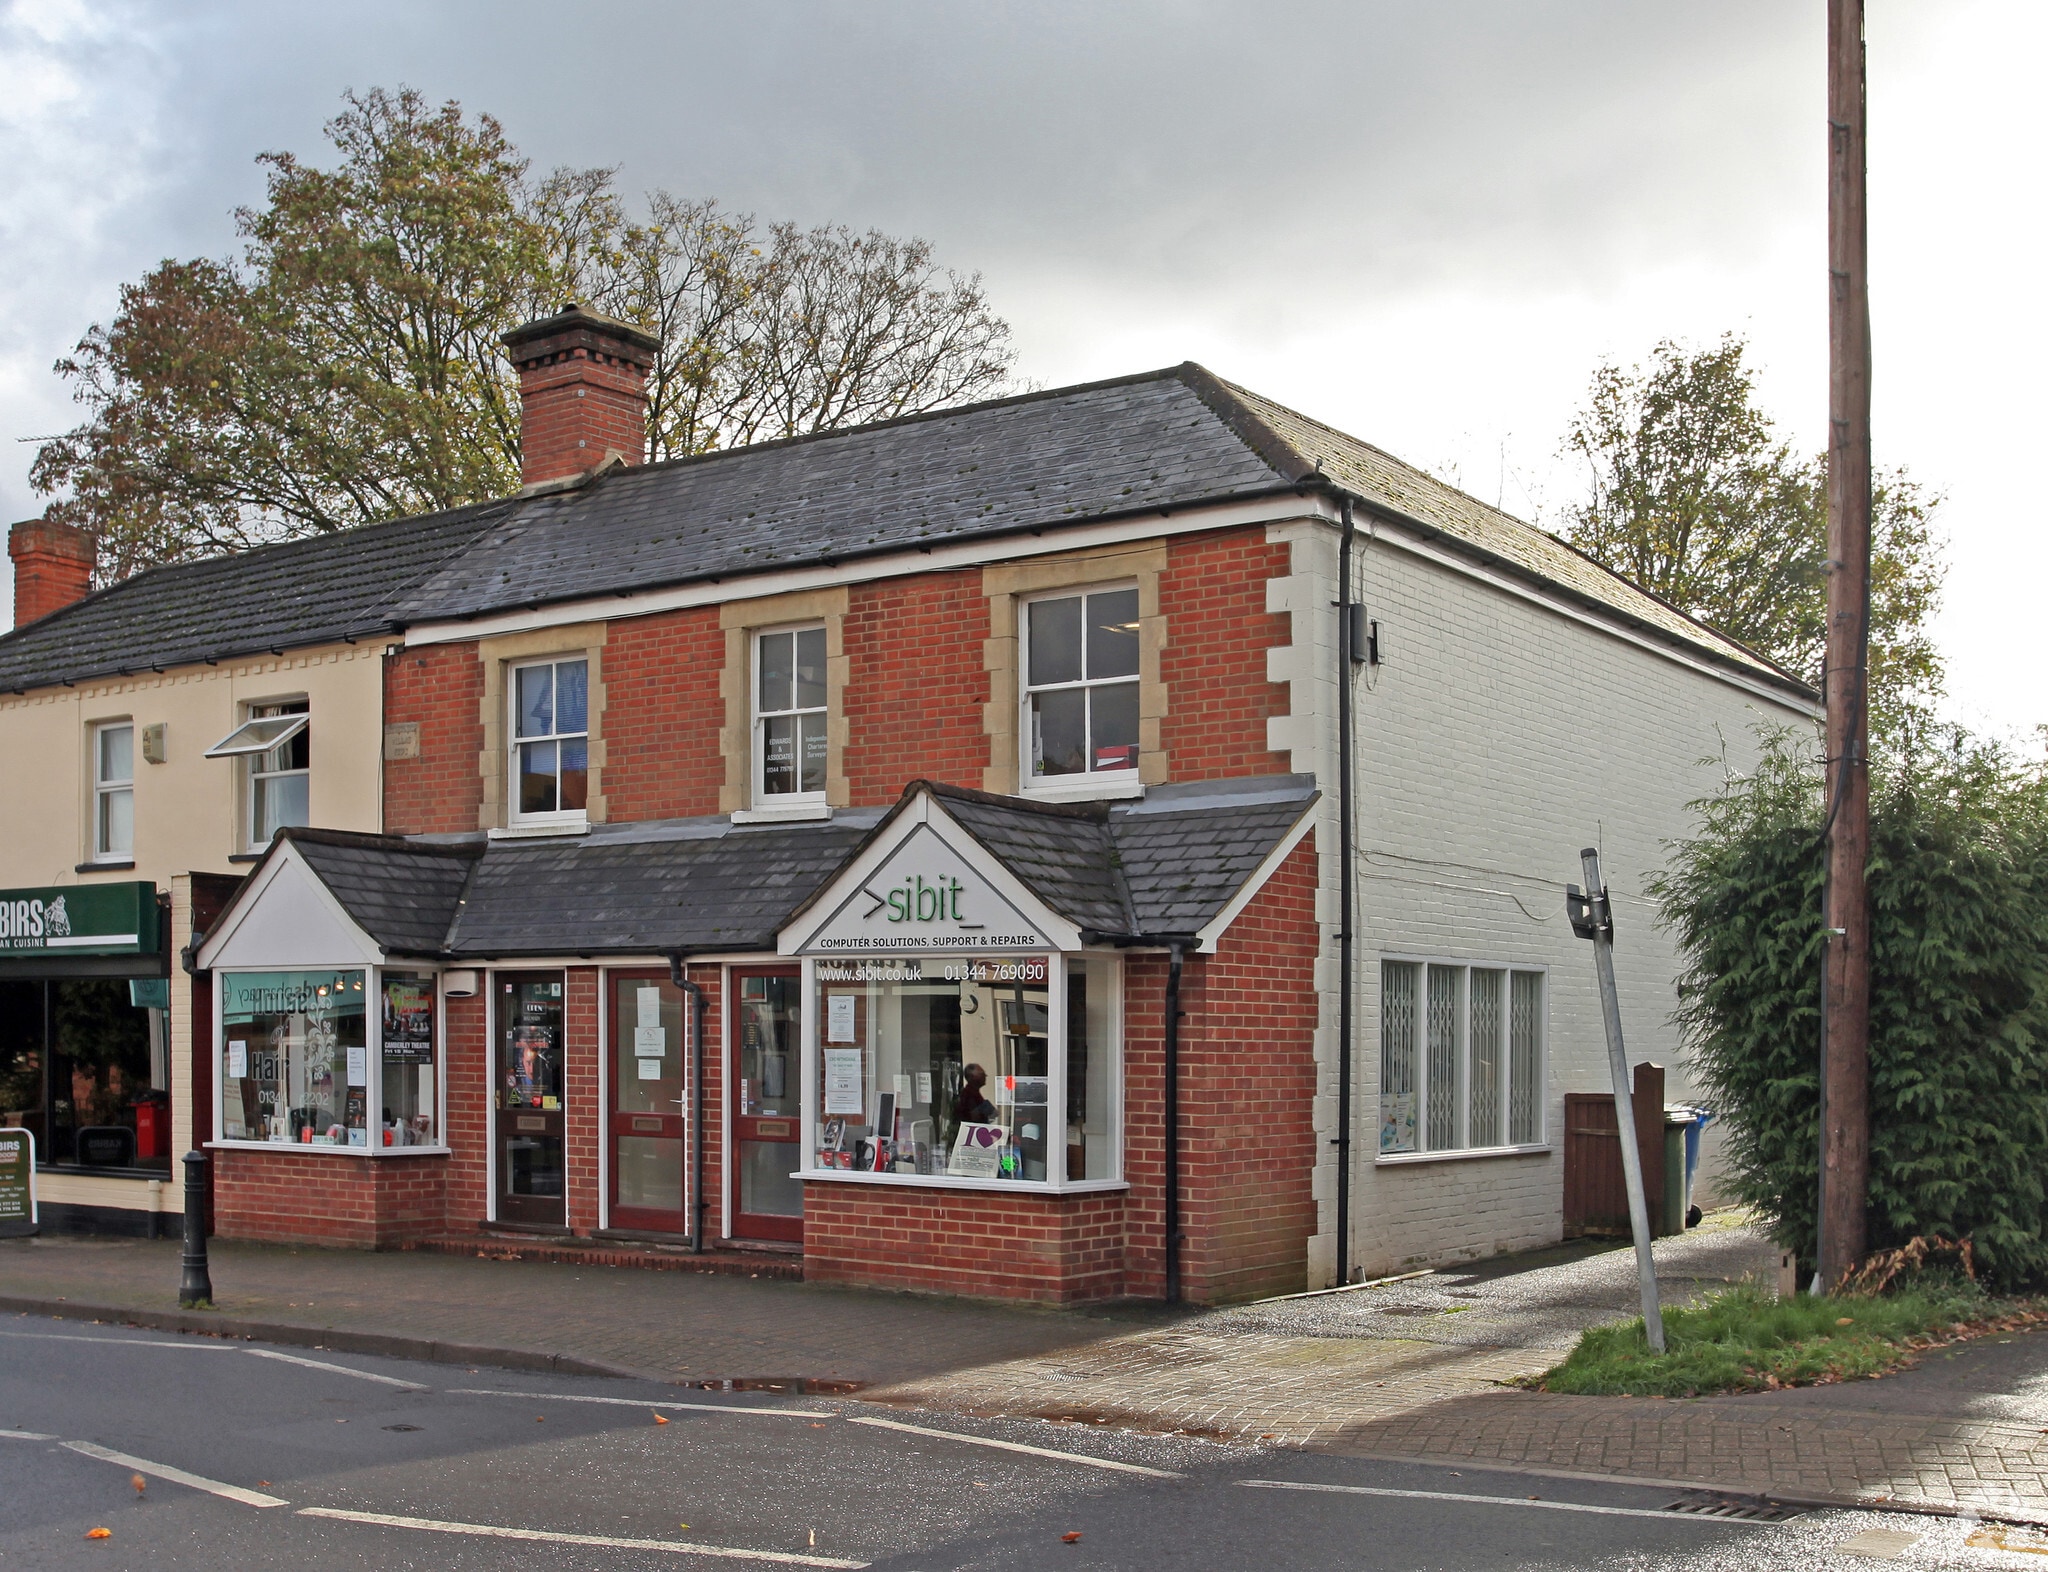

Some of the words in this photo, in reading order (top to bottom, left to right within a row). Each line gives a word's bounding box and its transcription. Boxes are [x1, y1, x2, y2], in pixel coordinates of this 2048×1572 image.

[769, 737, 792, 745] EDWARDS
[767, 753, 794, 761] ASSOCIATES
[14, 938, 44, 948] CUISINE
[820, 938, 870, 948] COMPUTER
[873, 937, 930, 947] SOLUTIONS,
[932, 937, 979, 946] SUPPORT
[981, 936, 988, 946] &
[991, 936, 1035, 945] REPAIRS
[820, 966, 922, 981] www.sibit.co.uk
[944, 965, 987, 980] 01344
[991, 965, 1044, 980] 769090
[411, 1041, 430, 1049] THEATRE
[252, 1052, 290, 1081] Hair
